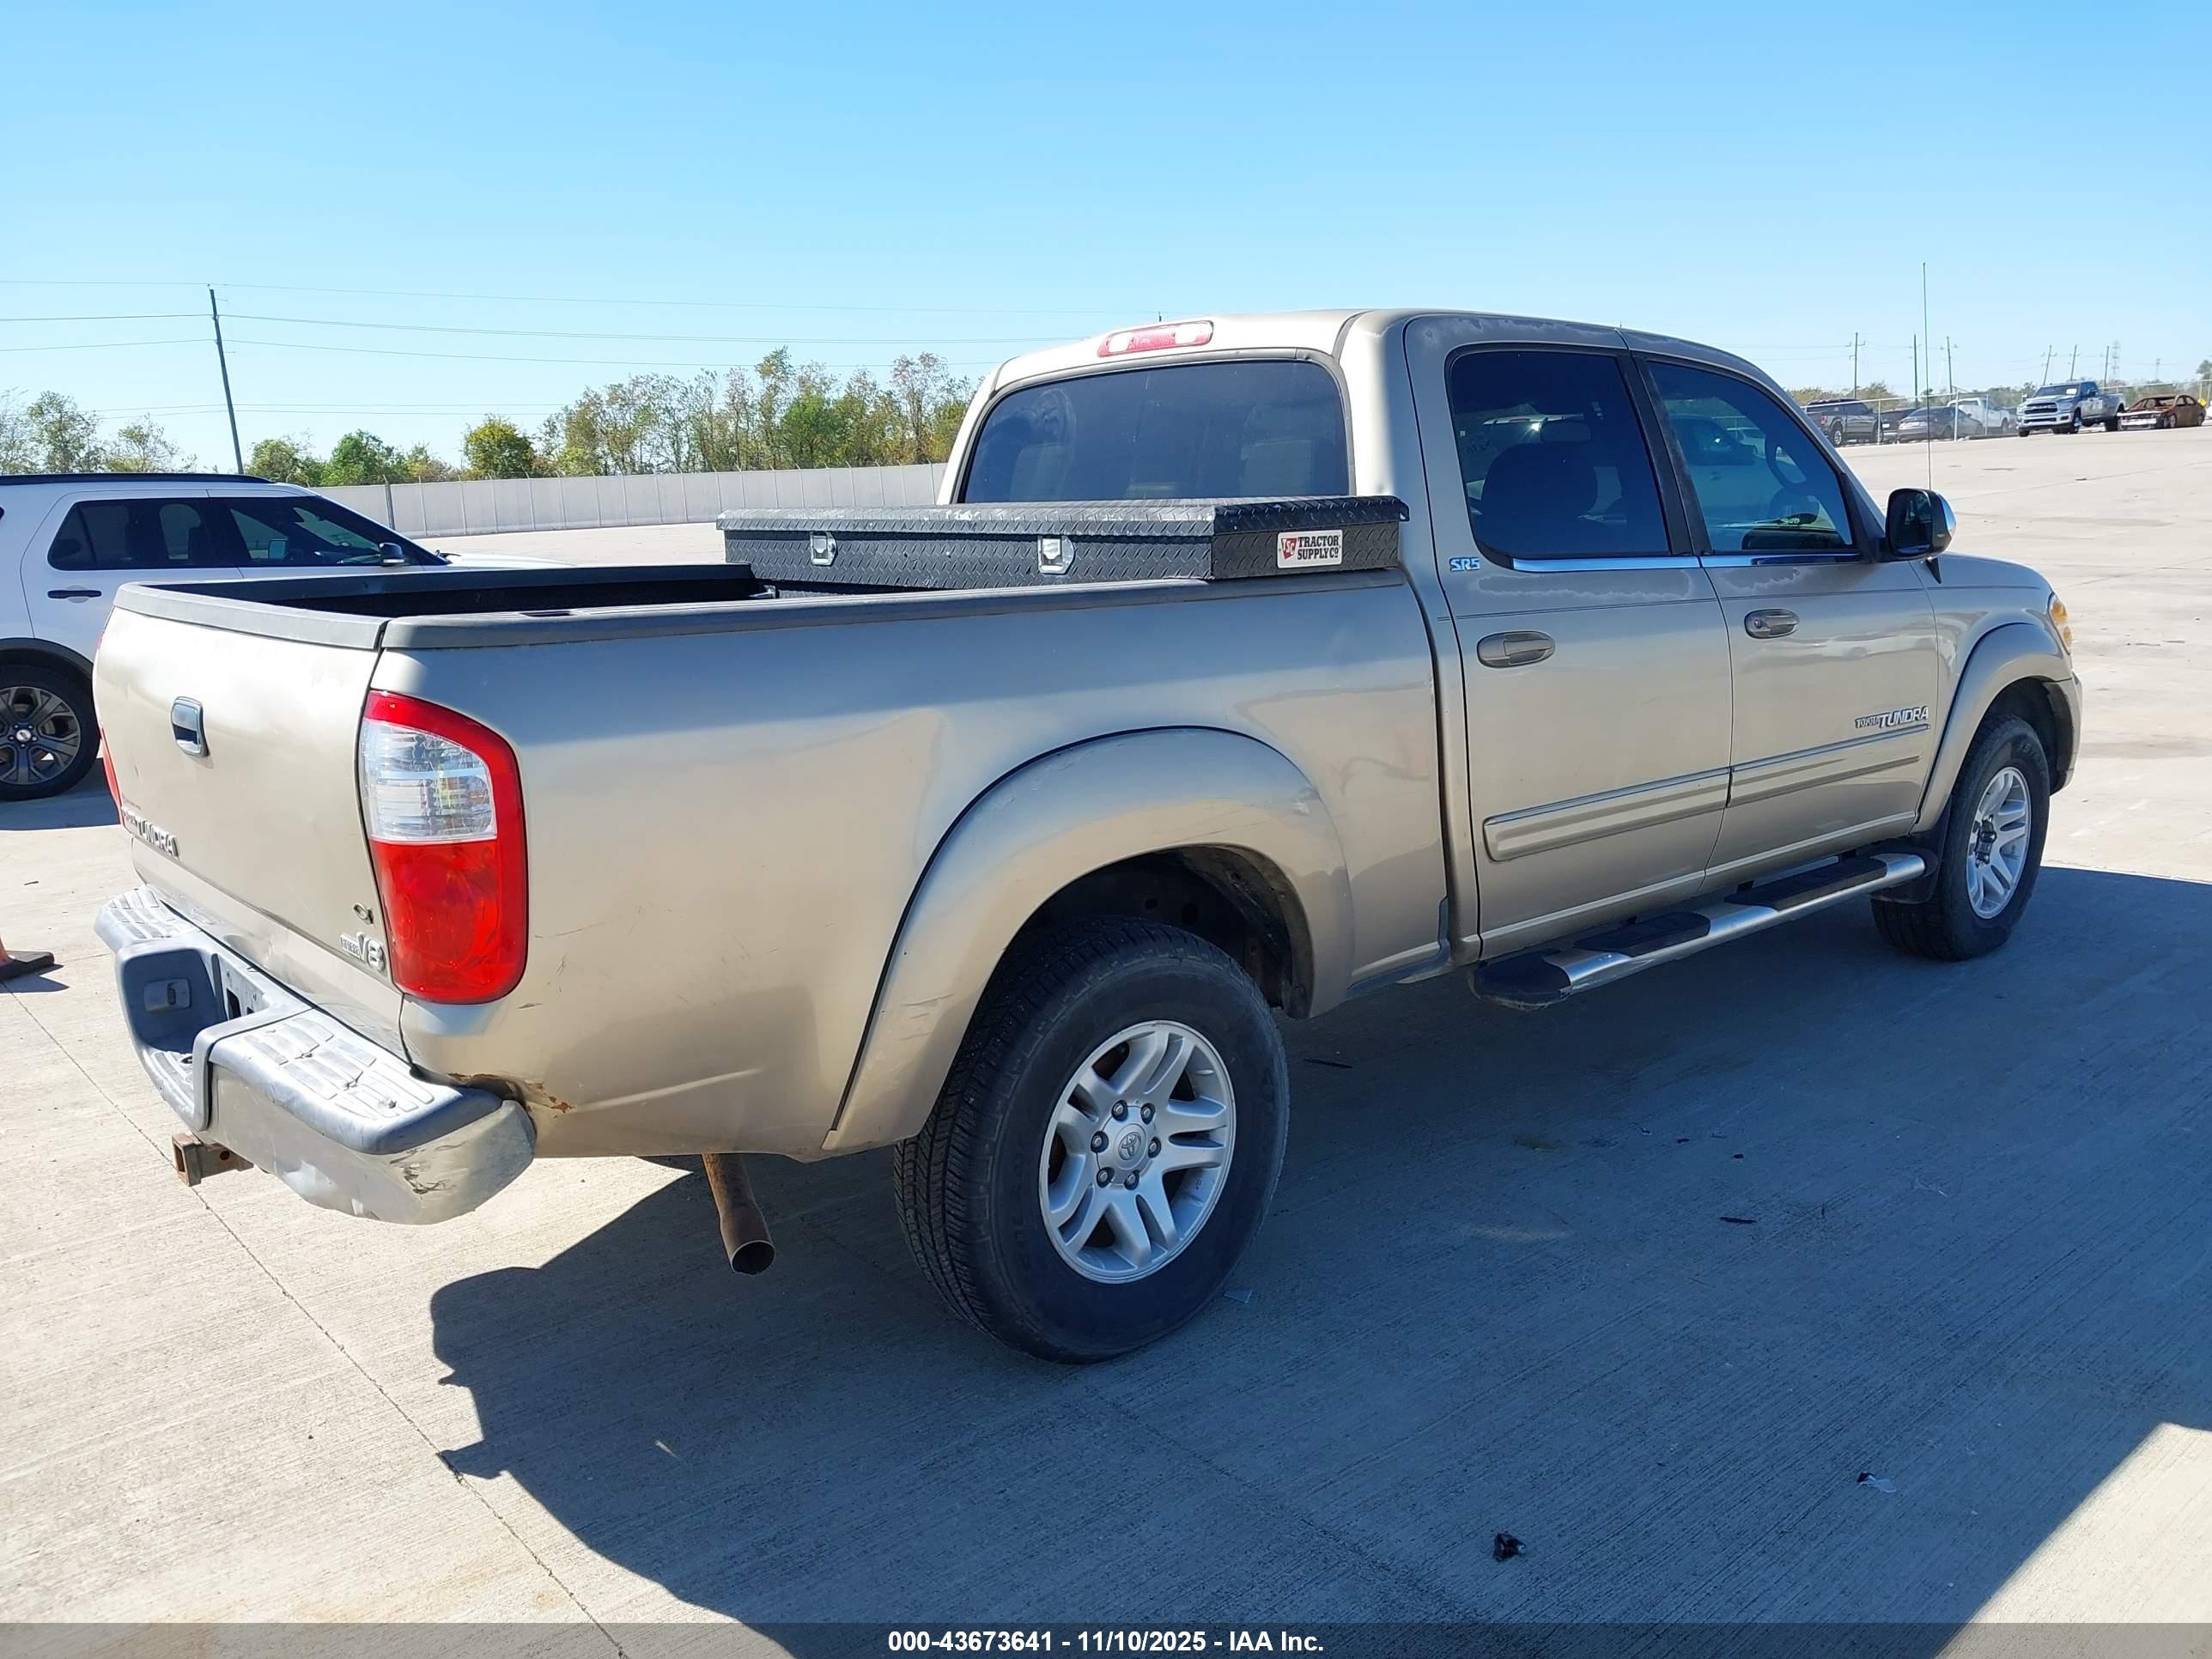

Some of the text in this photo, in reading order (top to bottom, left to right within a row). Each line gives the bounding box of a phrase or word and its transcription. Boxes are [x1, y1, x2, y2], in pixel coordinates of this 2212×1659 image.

[1297, 535, 1340, 548] TRACTOR
[1297, 548, 1328, 560] SUPPLY
[1449, 557, 1480, 571] SR5
[1879, 706, 1929, 728] TUNDRA
[356, 932, 386, 972] V8
